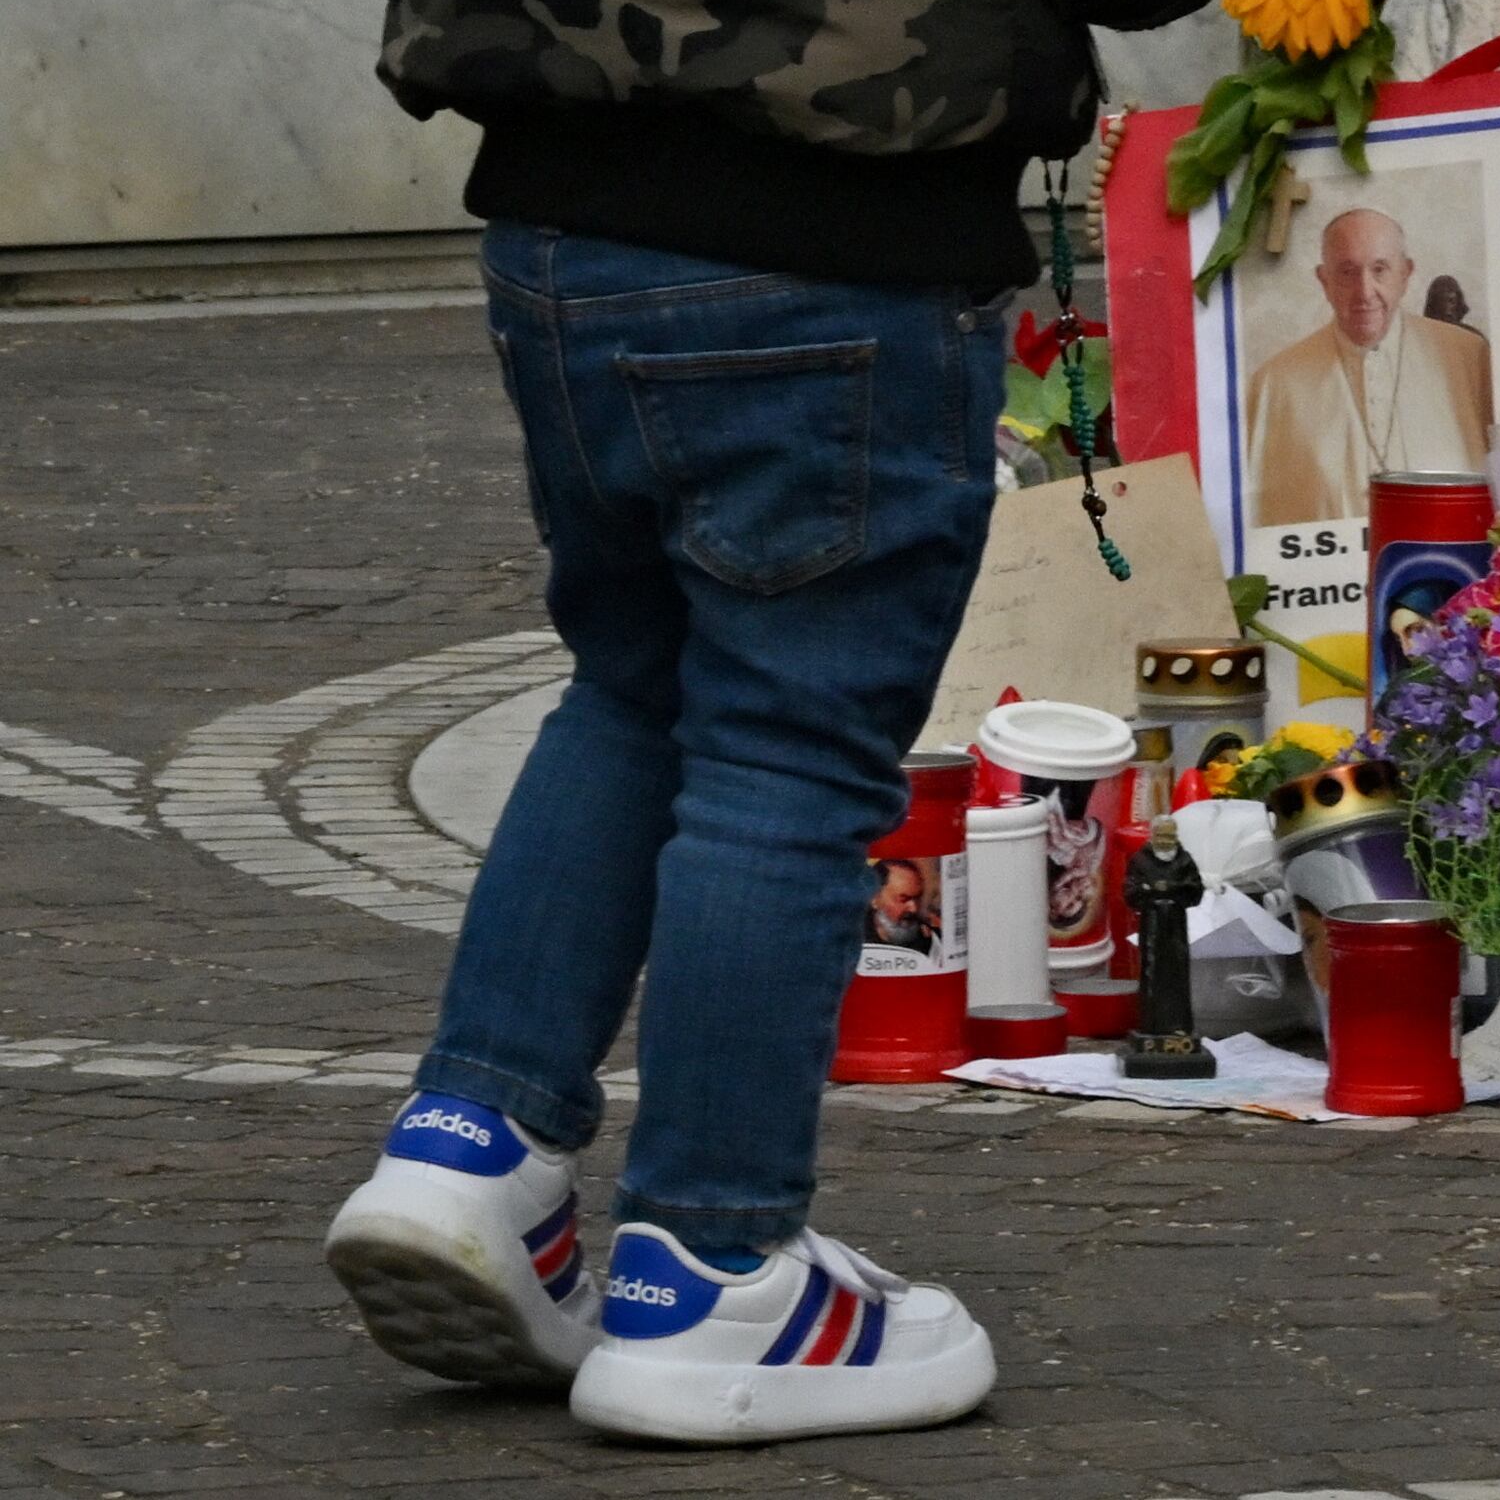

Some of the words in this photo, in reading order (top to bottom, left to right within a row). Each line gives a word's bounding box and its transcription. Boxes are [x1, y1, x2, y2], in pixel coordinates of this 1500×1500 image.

[1280, 530, 1348, 559] S.S.
[1262, 582, 1369, 610] Franc
[864, 957, 892, 971] San
[895, 957, 917, 970] Pio
[402, 1109, 492, 1147] adidas
